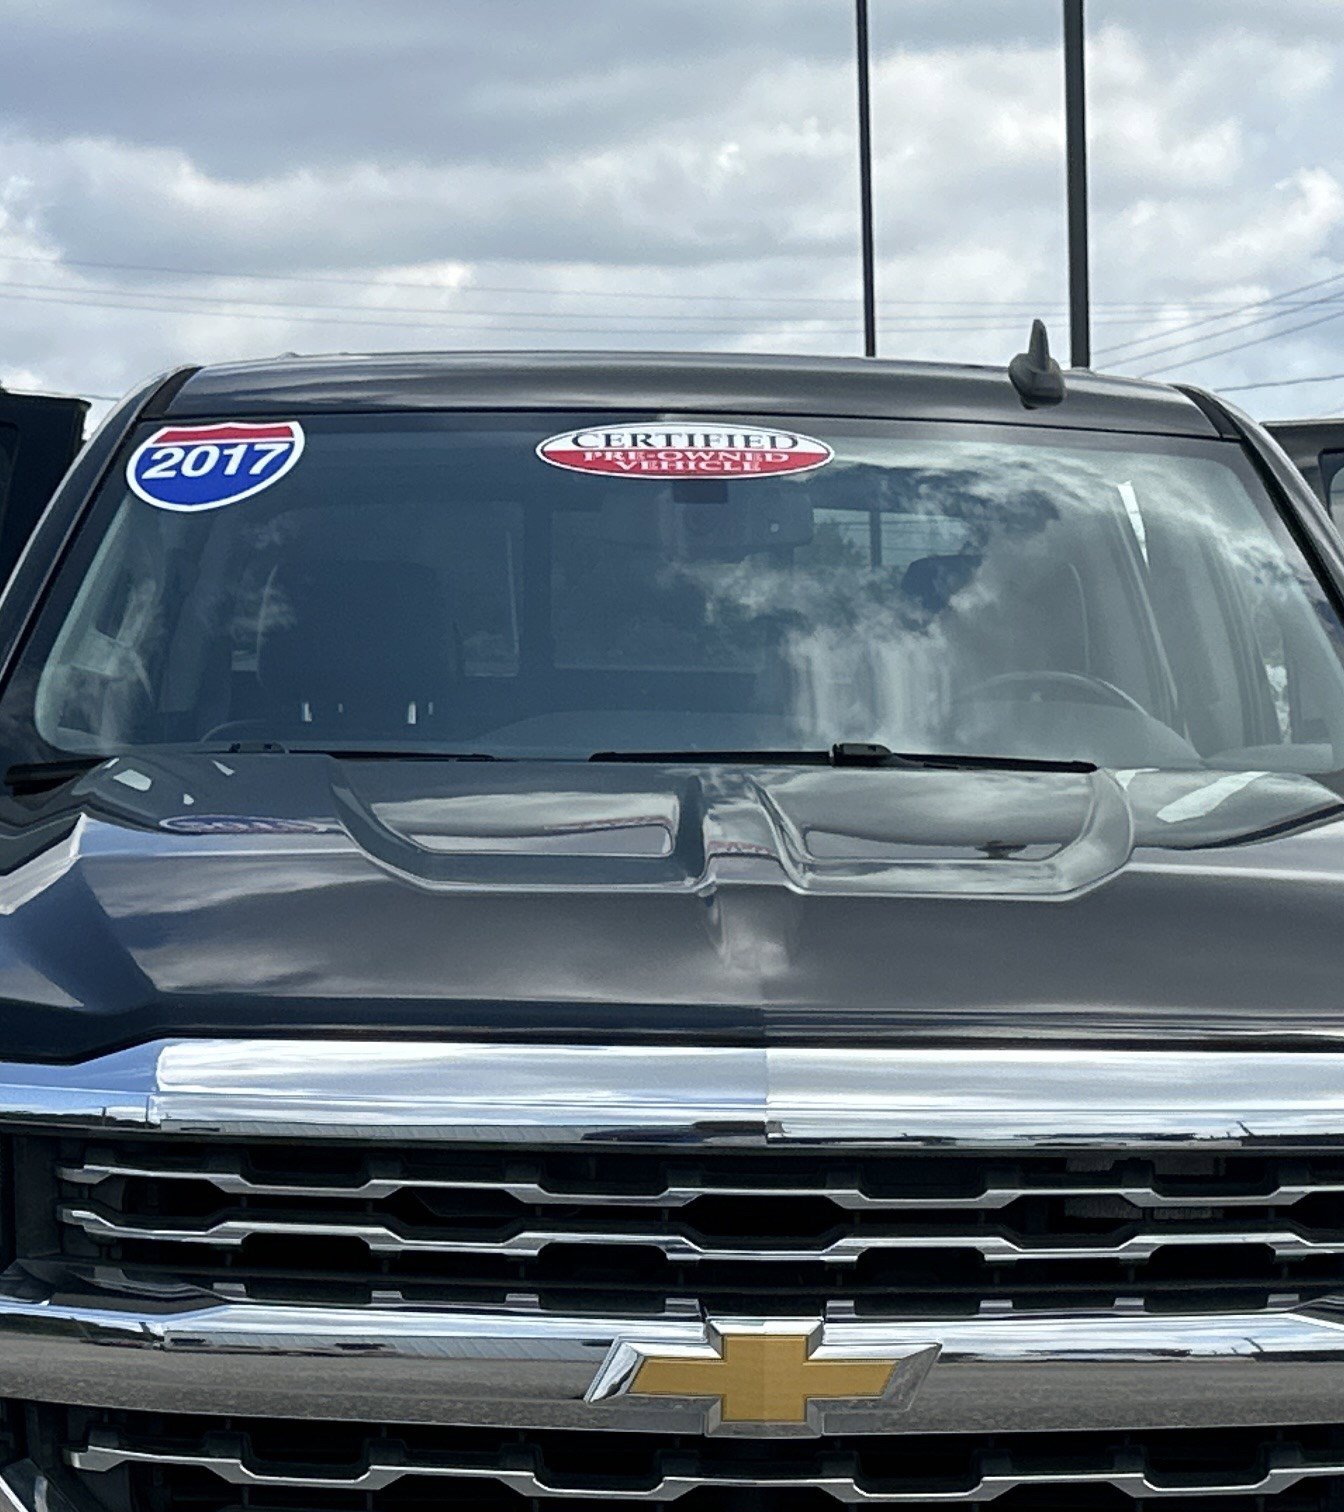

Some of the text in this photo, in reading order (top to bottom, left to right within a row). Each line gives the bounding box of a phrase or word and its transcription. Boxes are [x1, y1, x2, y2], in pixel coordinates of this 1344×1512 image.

[571, 432, 798, 450] CERTIFIED
[141, 442, 291, 480] 2017
[582, 451, 790, 463] PRE-OWNED
[614, 461, 763, 473] VEHICLE
